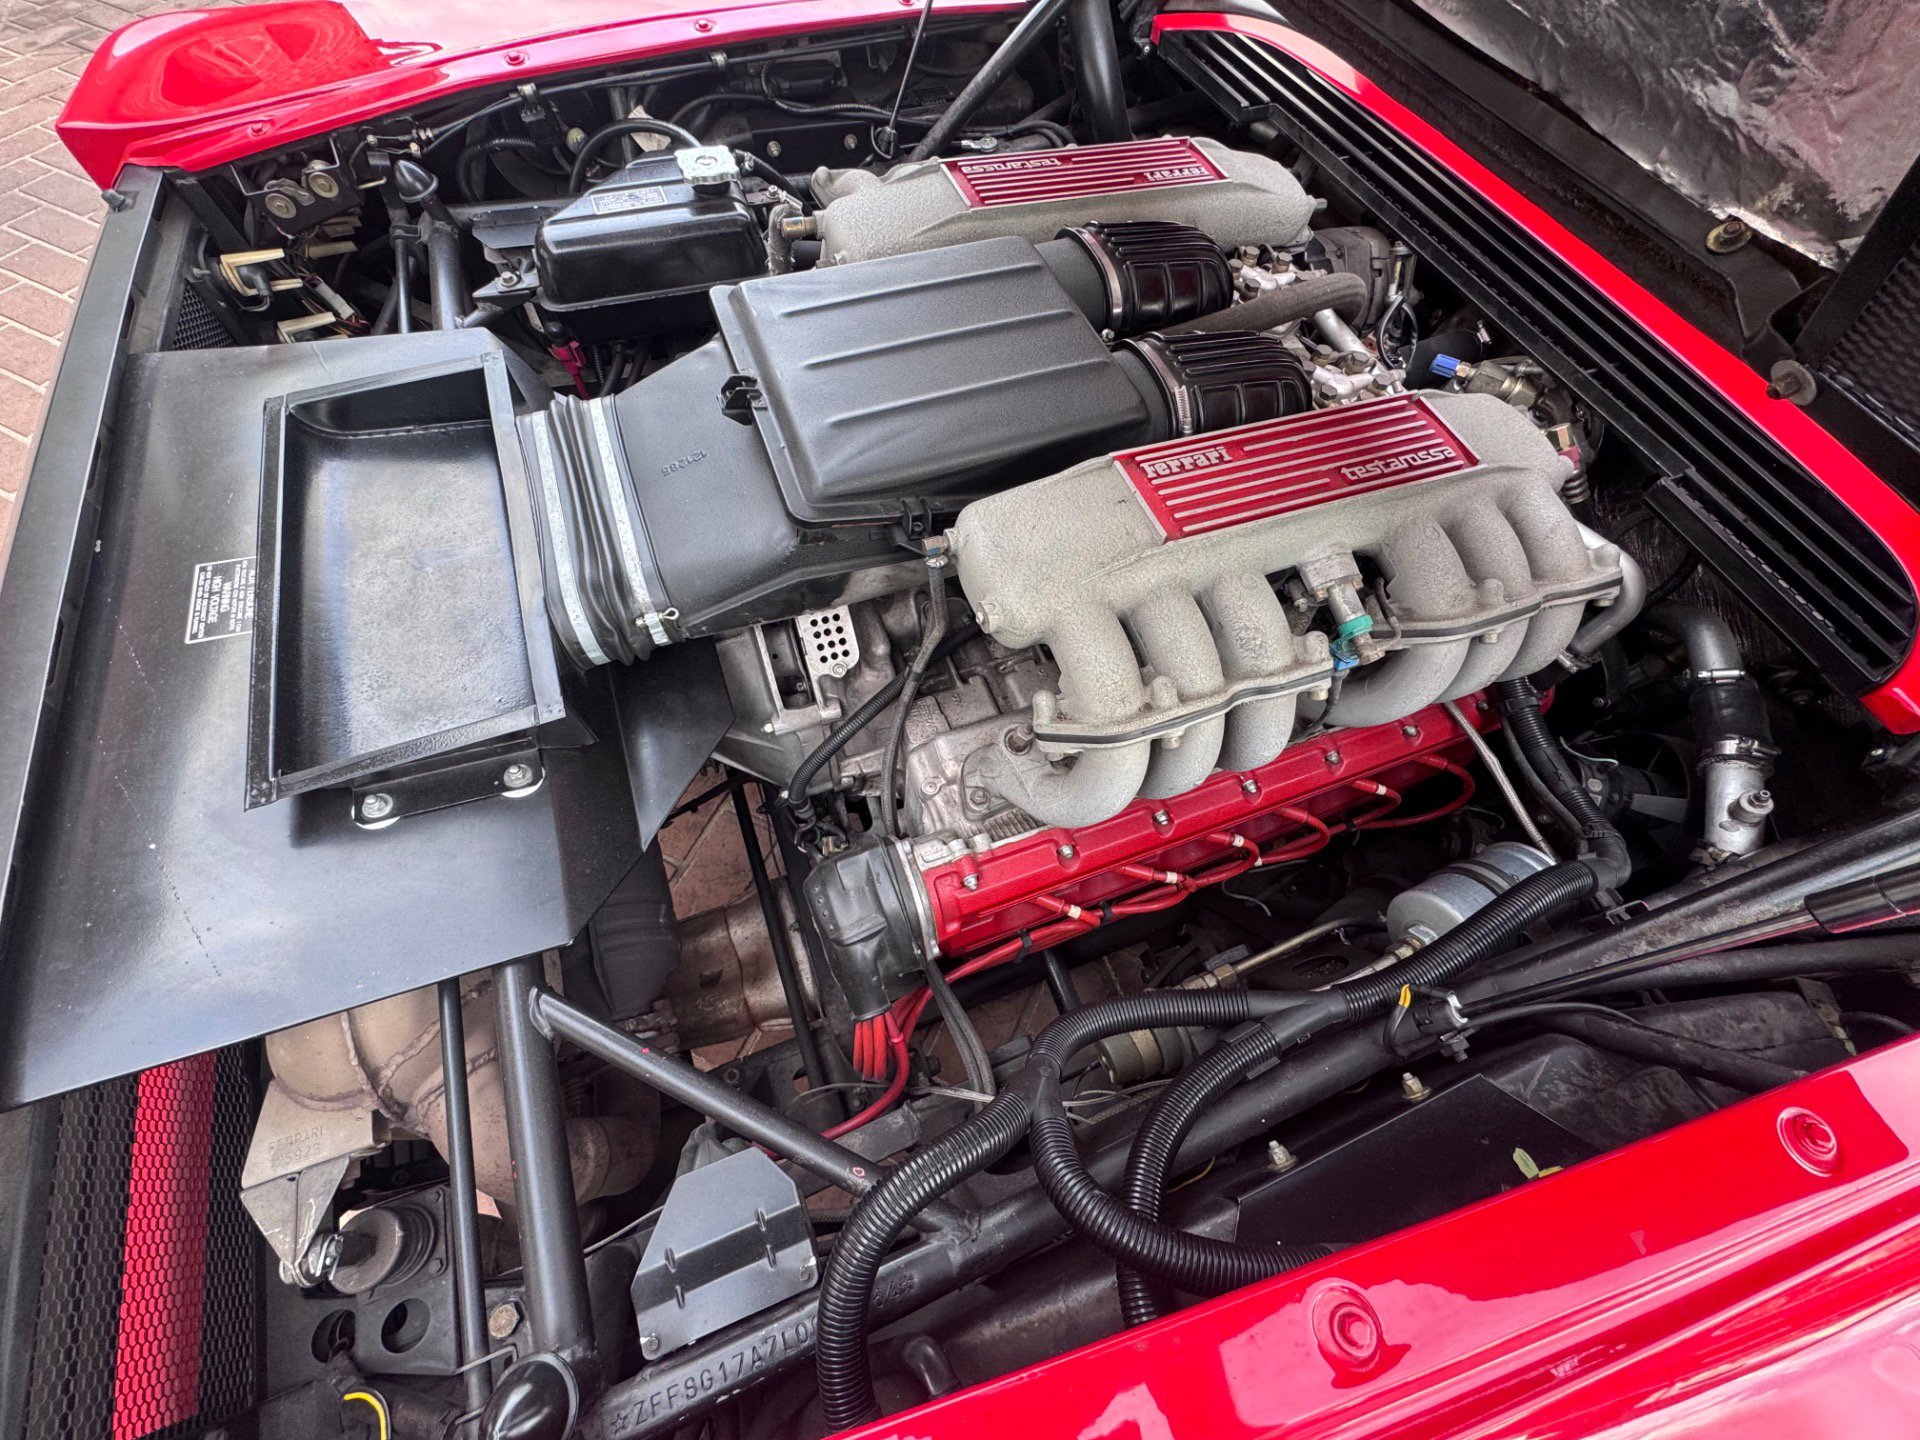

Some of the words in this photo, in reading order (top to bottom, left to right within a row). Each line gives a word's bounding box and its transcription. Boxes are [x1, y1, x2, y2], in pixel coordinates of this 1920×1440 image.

[1144, 166, 1207, 182] Ferrari
[1140, 446, 1232, 479] Ferrari
[1341, 446, 1457, 480] testarossa
[211, 575, 222, 592] HIGH
[220, 581, 232, 613] WARNING
[207, 593, 220, 624] VOLTAGE
